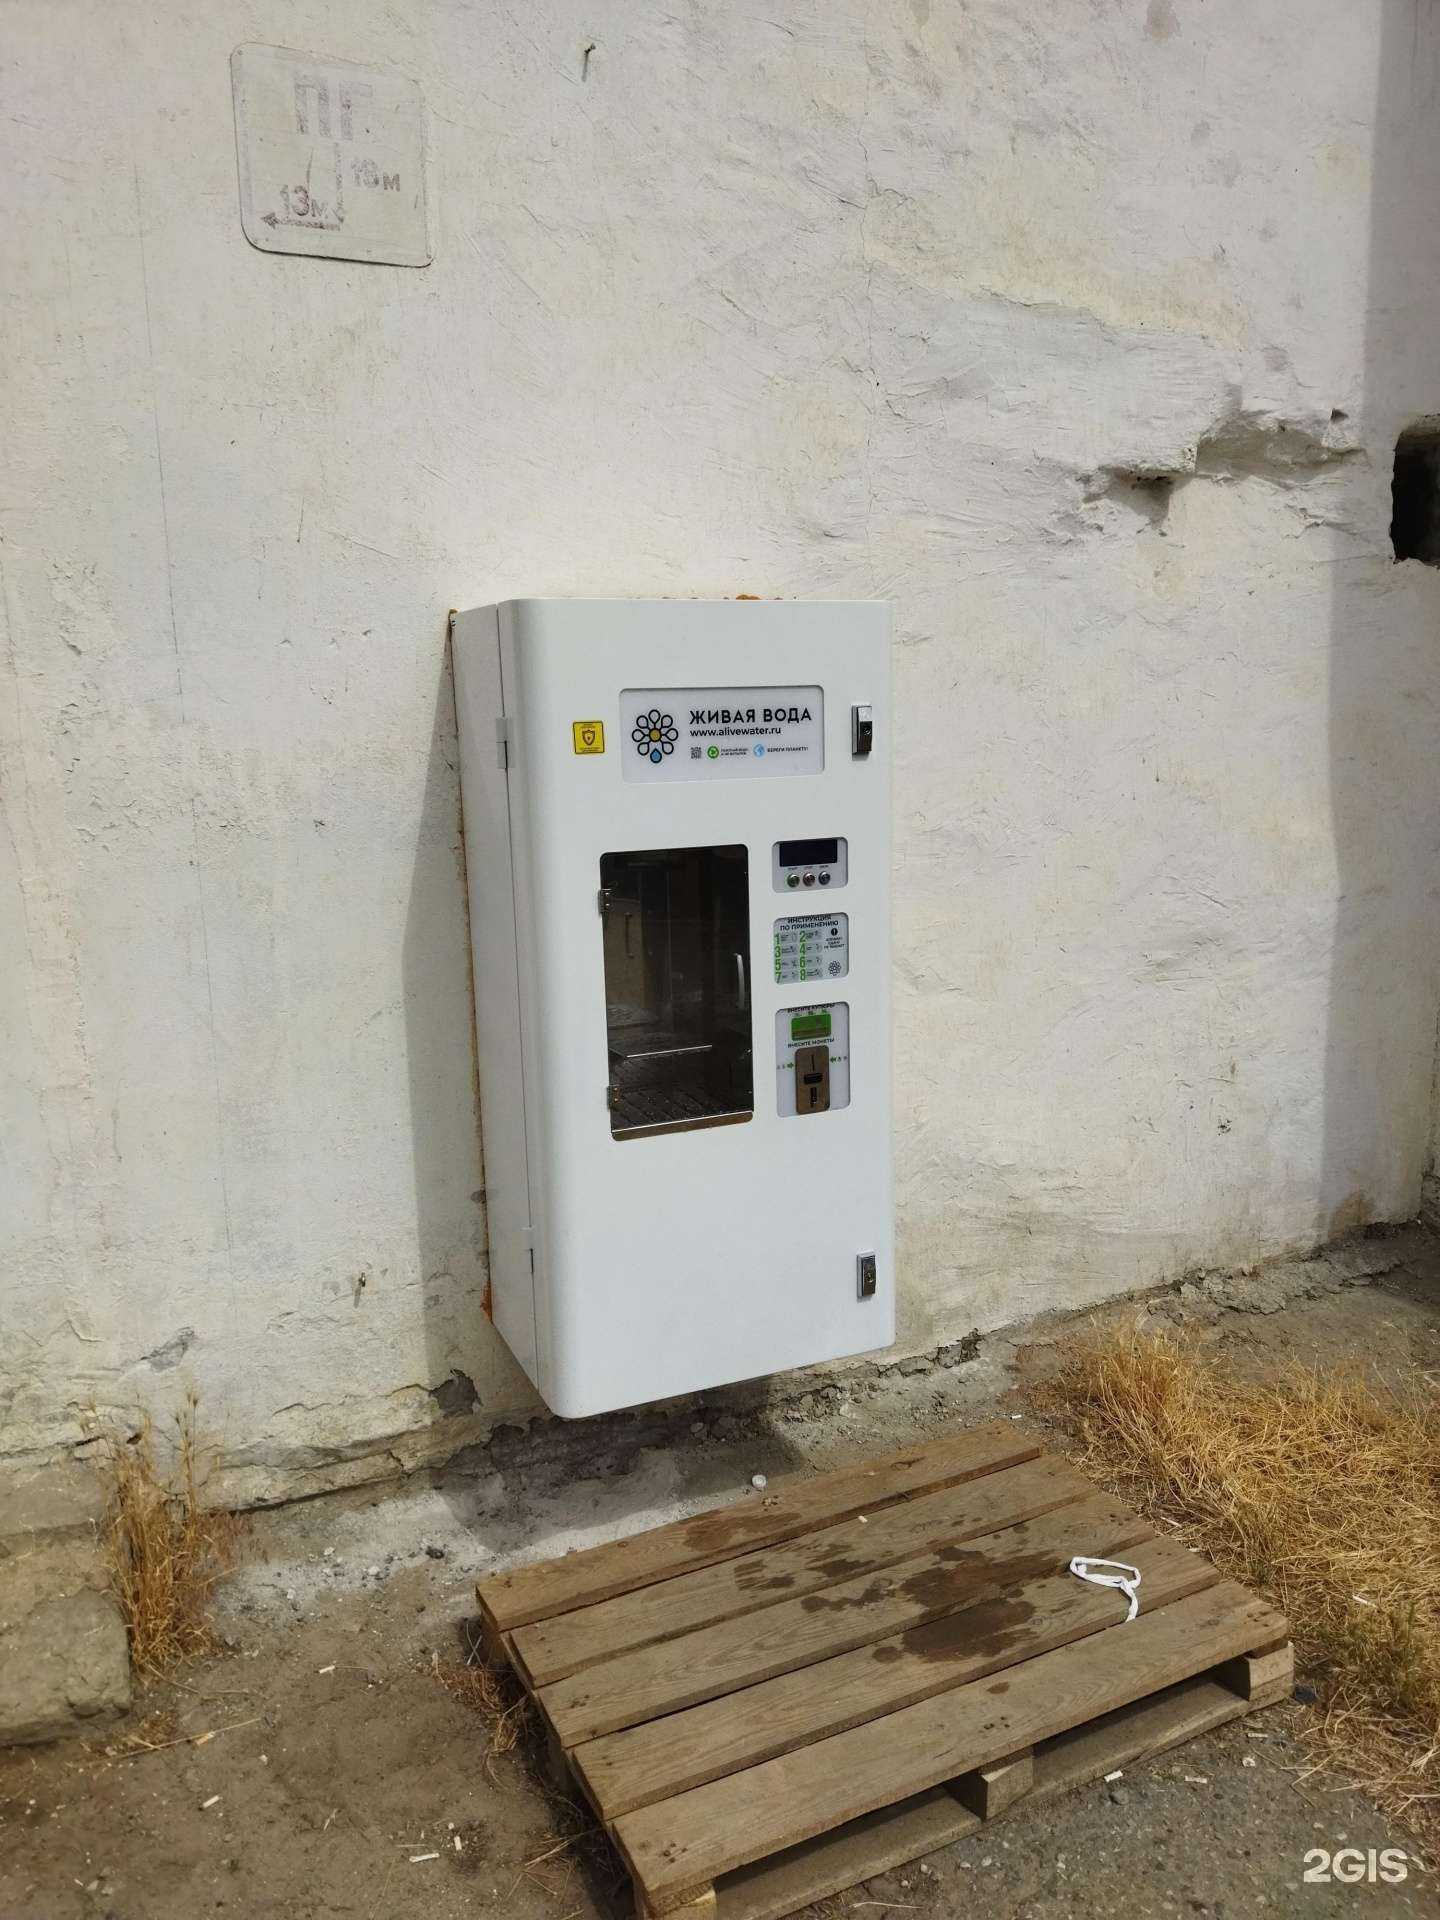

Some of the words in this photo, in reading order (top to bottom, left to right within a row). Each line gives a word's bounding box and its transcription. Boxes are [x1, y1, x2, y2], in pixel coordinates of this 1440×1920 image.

[293, 73, 373, 141] ПГ
[689, 708, 756, 725] ЖИВАЯ
[763, 707, 812, 724] ВОДА
[689, 726, 782, 737] www.alivewater.ru
[791, 920, 839, 930] ПРИМЕНЕНИЮ
[774, 932, 780, 945] 1
[799, 930, 806, 943] 2
[774, 945, 781, 958] 3
[799, 943, 806, 955] 4
[775, 958, 781, 971] 5
[799, 956, 806, 968] 6
[775, 971, 782, 984] 7
[799, 968, 806, 981] 8
